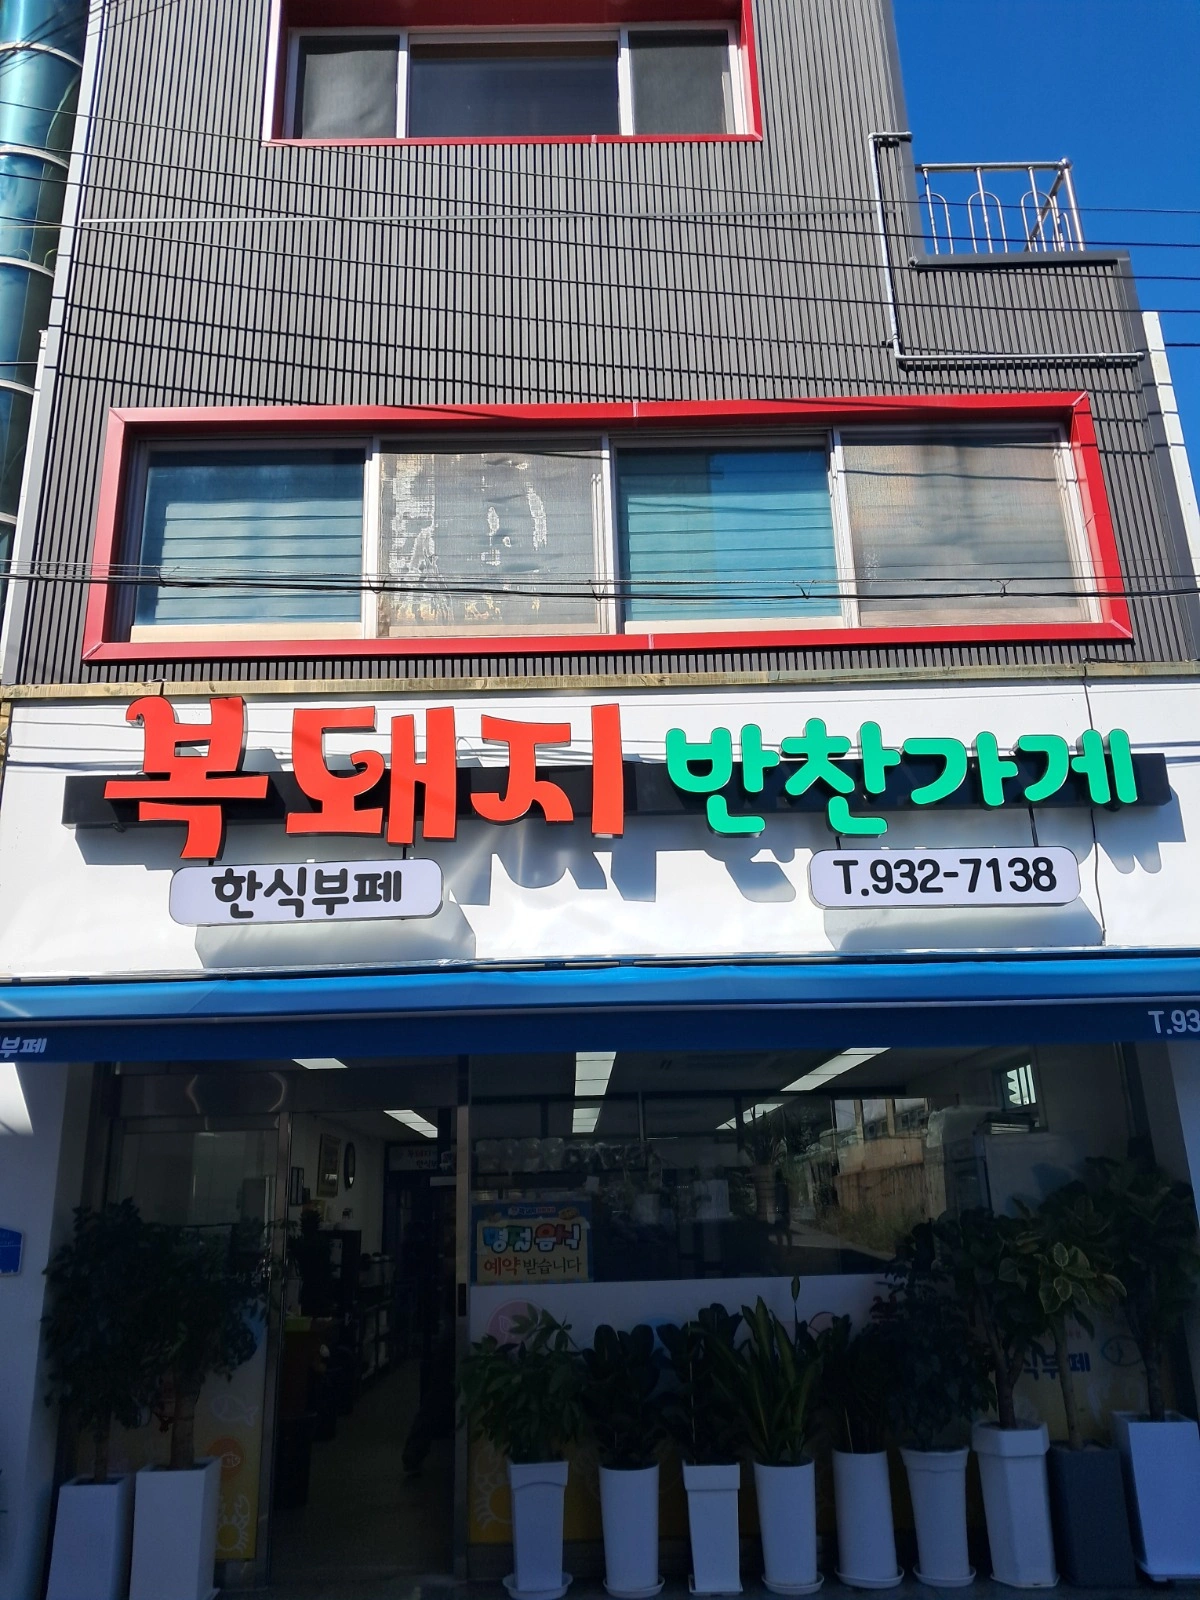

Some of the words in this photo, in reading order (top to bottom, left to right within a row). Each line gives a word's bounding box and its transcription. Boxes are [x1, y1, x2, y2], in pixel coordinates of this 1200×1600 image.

[104, 697, 624, 860] 복돼지
[665, 718, 1138, 836] 반찬가게
[210, 867, 402, 920] 한식부페
[832, 857, 1058, 898] T.932-7138
[482, 1225, 533, 1254] 명절
[534, 1223, 582, 1252] 음식
[484, 1256, 521, 1276] 예약
[522, 1256, 582, 1275] 받습니다
